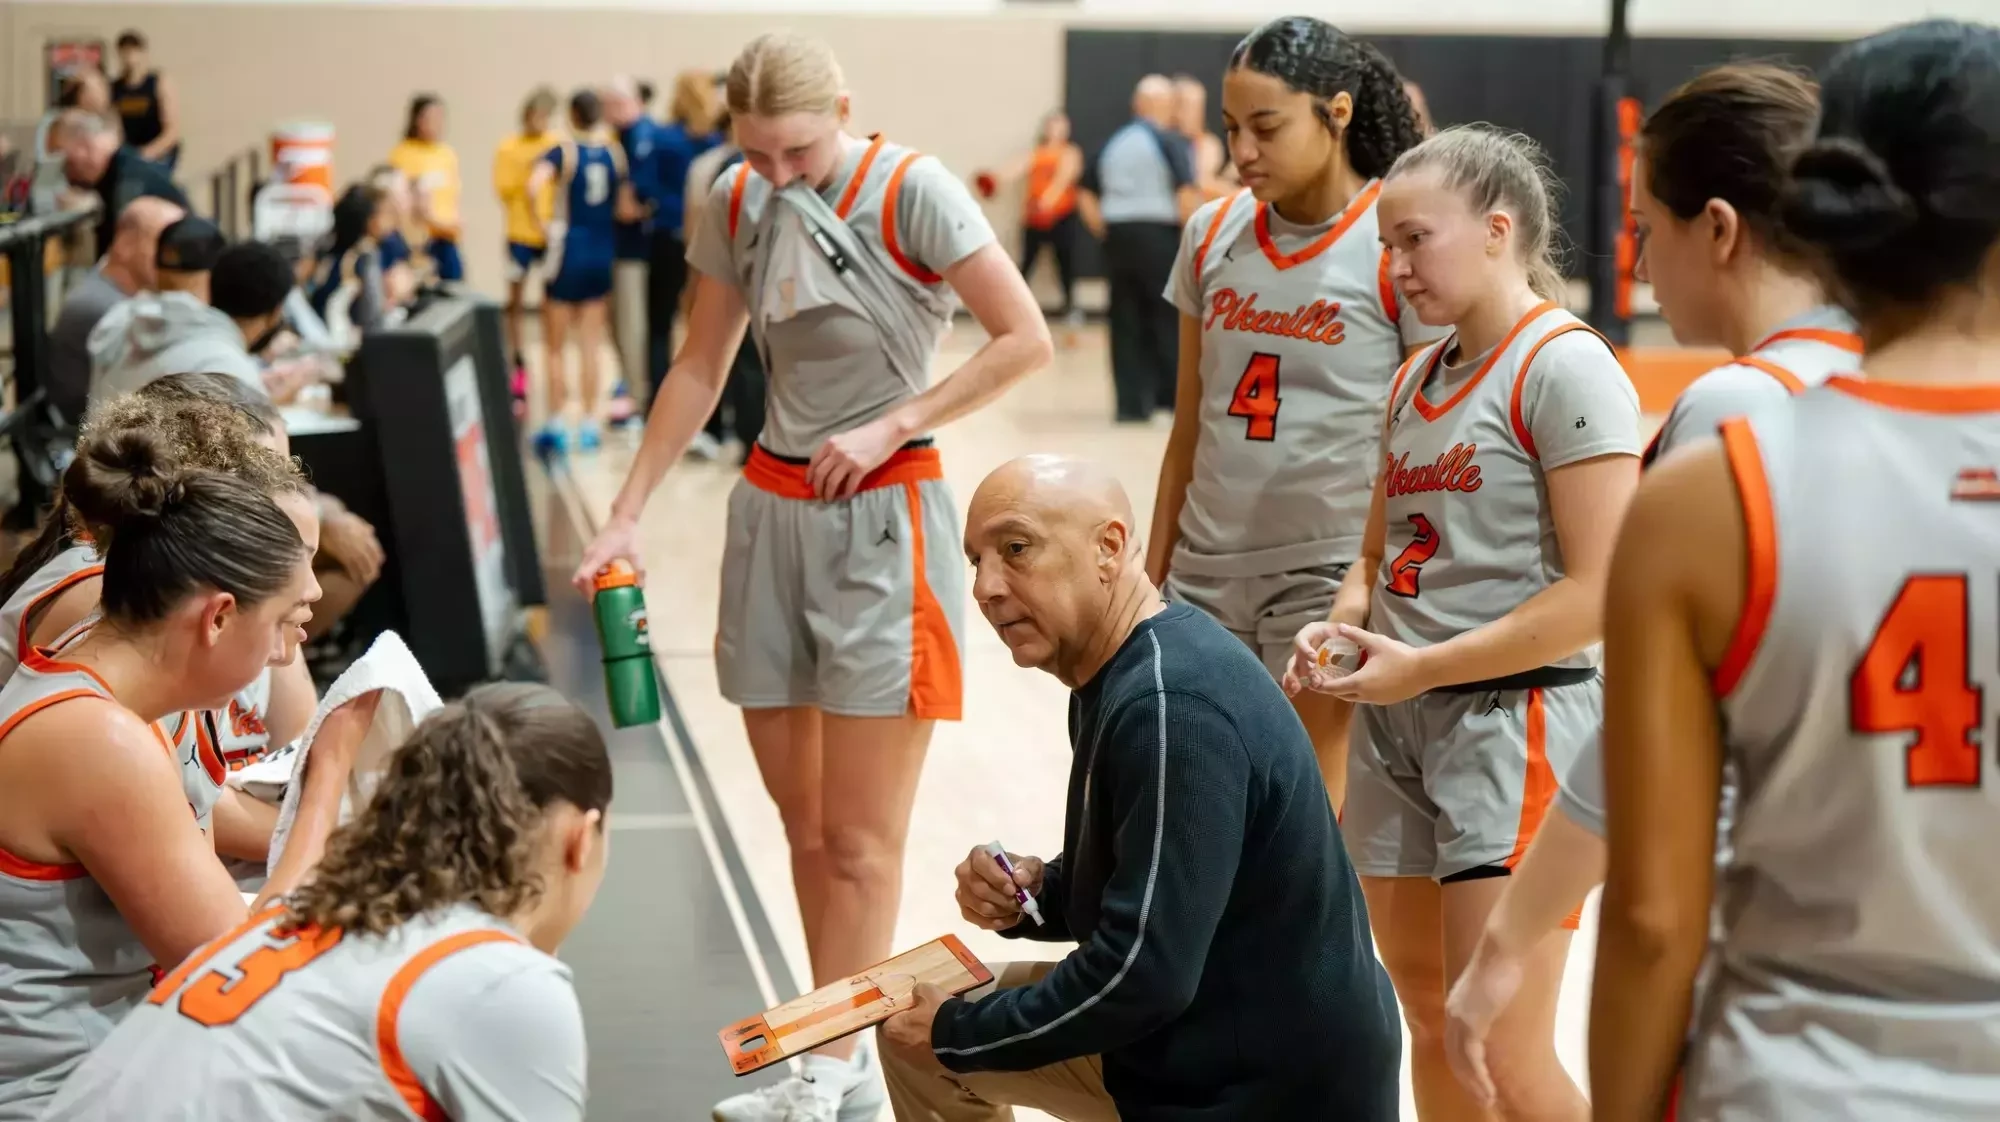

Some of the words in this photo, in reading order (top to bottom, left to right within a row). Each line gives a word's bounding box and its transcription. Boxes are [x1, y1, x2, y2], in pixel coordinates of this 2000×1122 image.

[1205, 287, 1346, 345] Pikeville
[1228, 351, 1282, 442] 4
[1385, 512, 1440, 599] 2
[1848, 571, 2000, 789] 4
